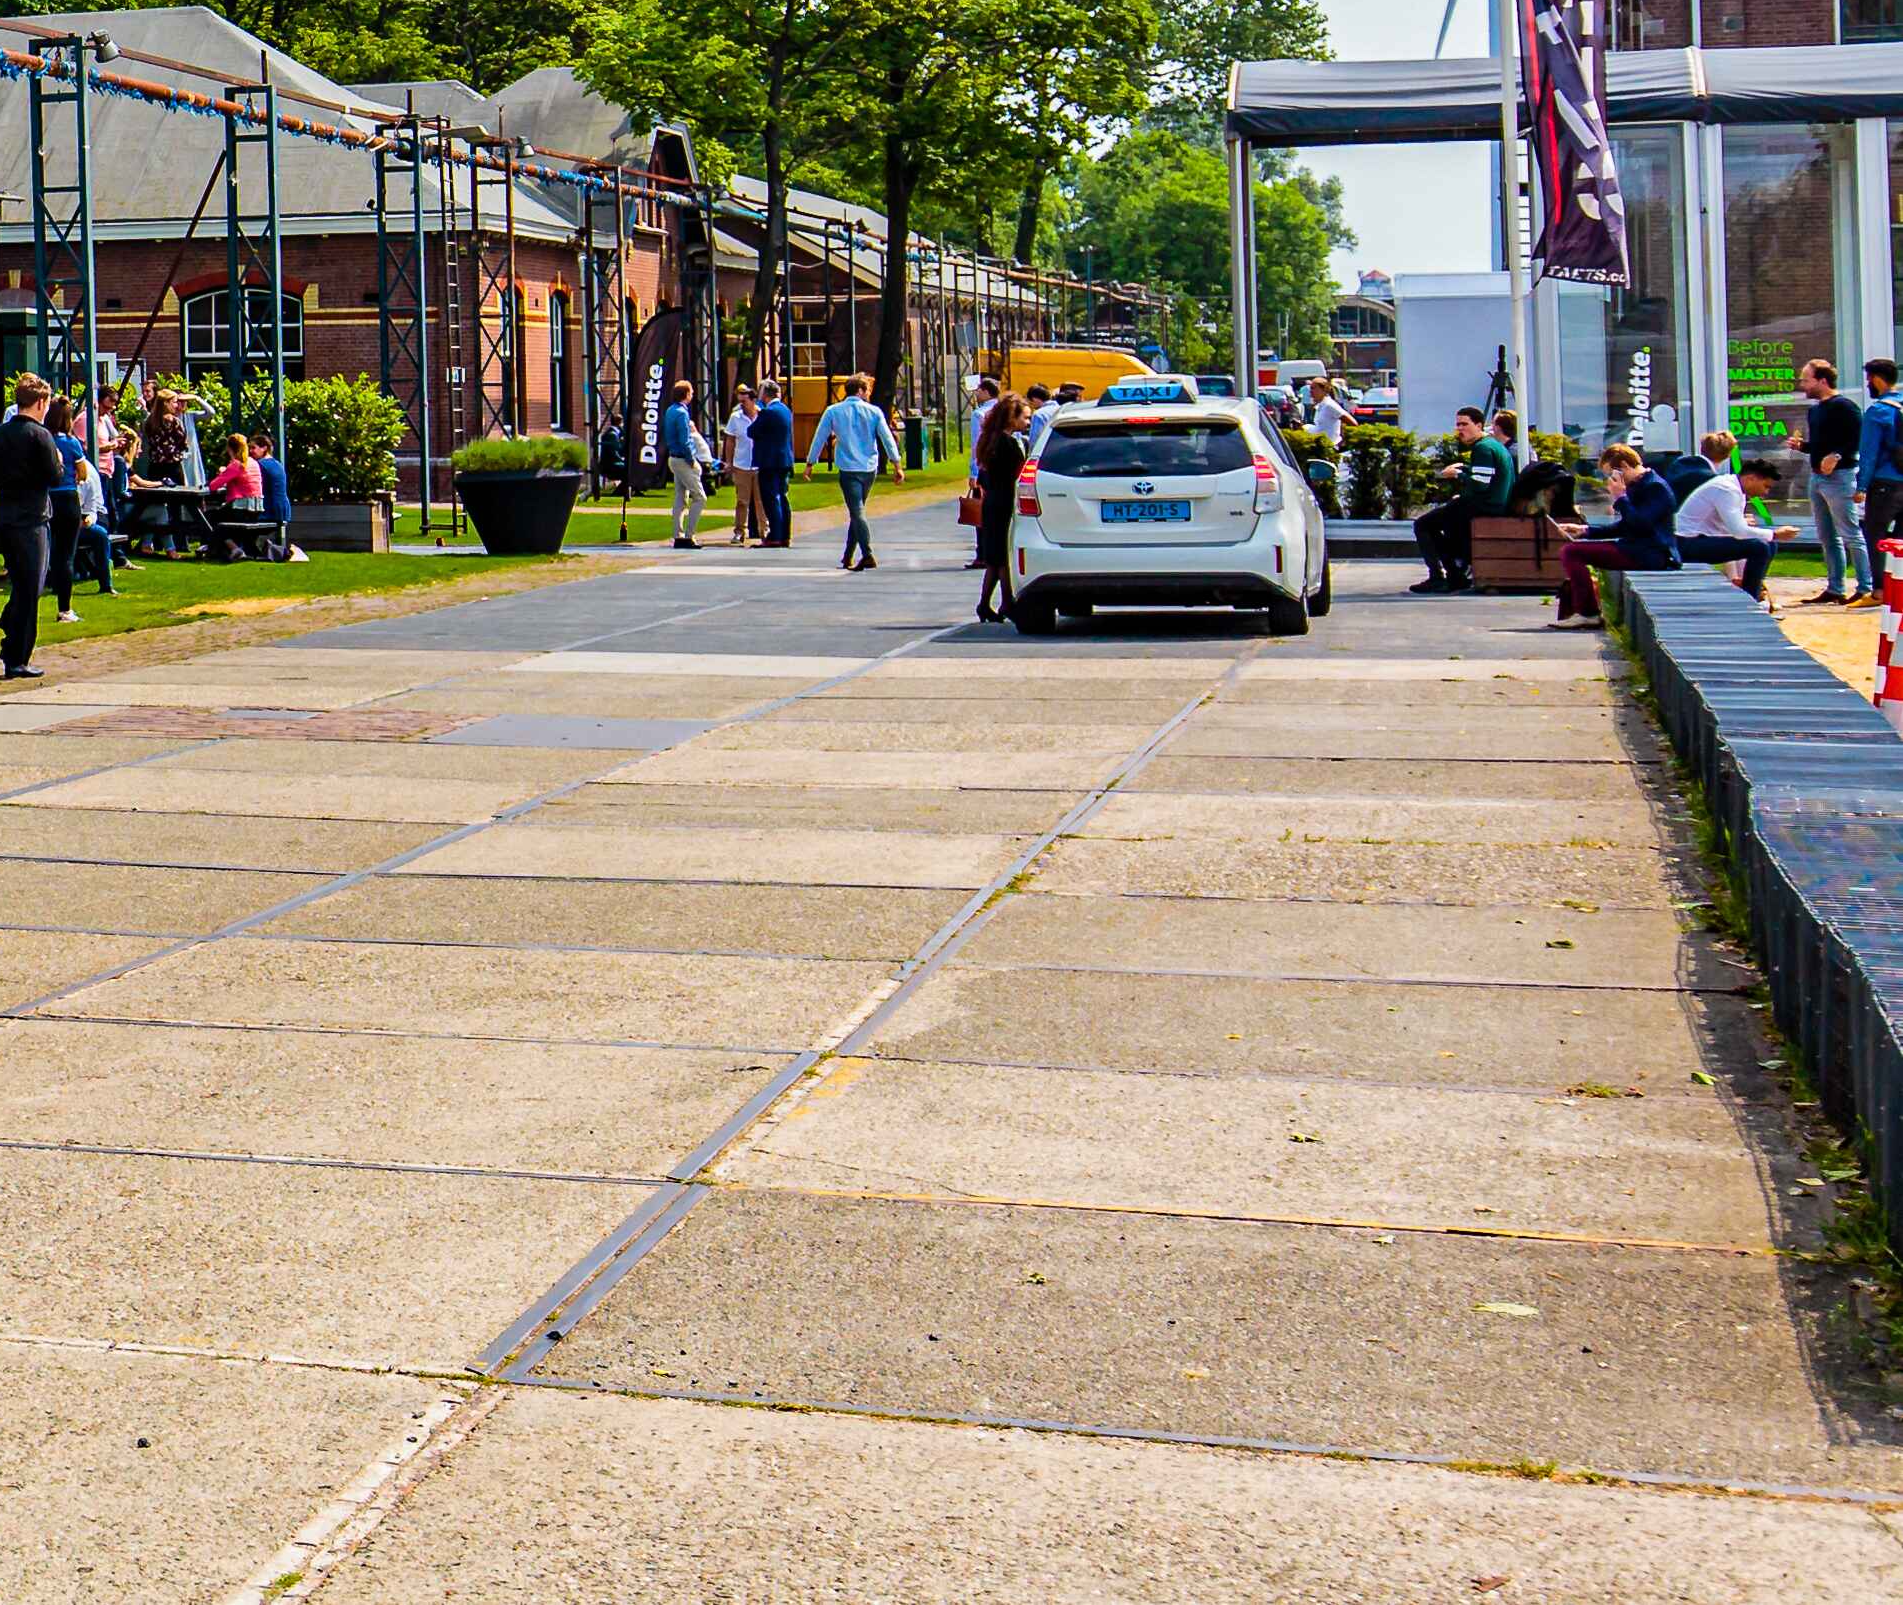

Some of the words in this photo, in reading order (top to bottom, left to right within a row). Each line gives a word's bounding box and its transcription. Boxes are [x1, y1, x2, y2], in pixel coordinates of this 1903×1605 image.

[1728, 338, 1794, 355] Before
[1727, 368, 1795, 380] MASTER
[1118, 386, 1171, 398] TAXI
[640, 358, 664, 464] Deloitte.
[1730, 405, 1765, 421] BIG
[1730, 421, 1787, 436] DATA
[1113, 504, 1179, 517] HT-201-S
